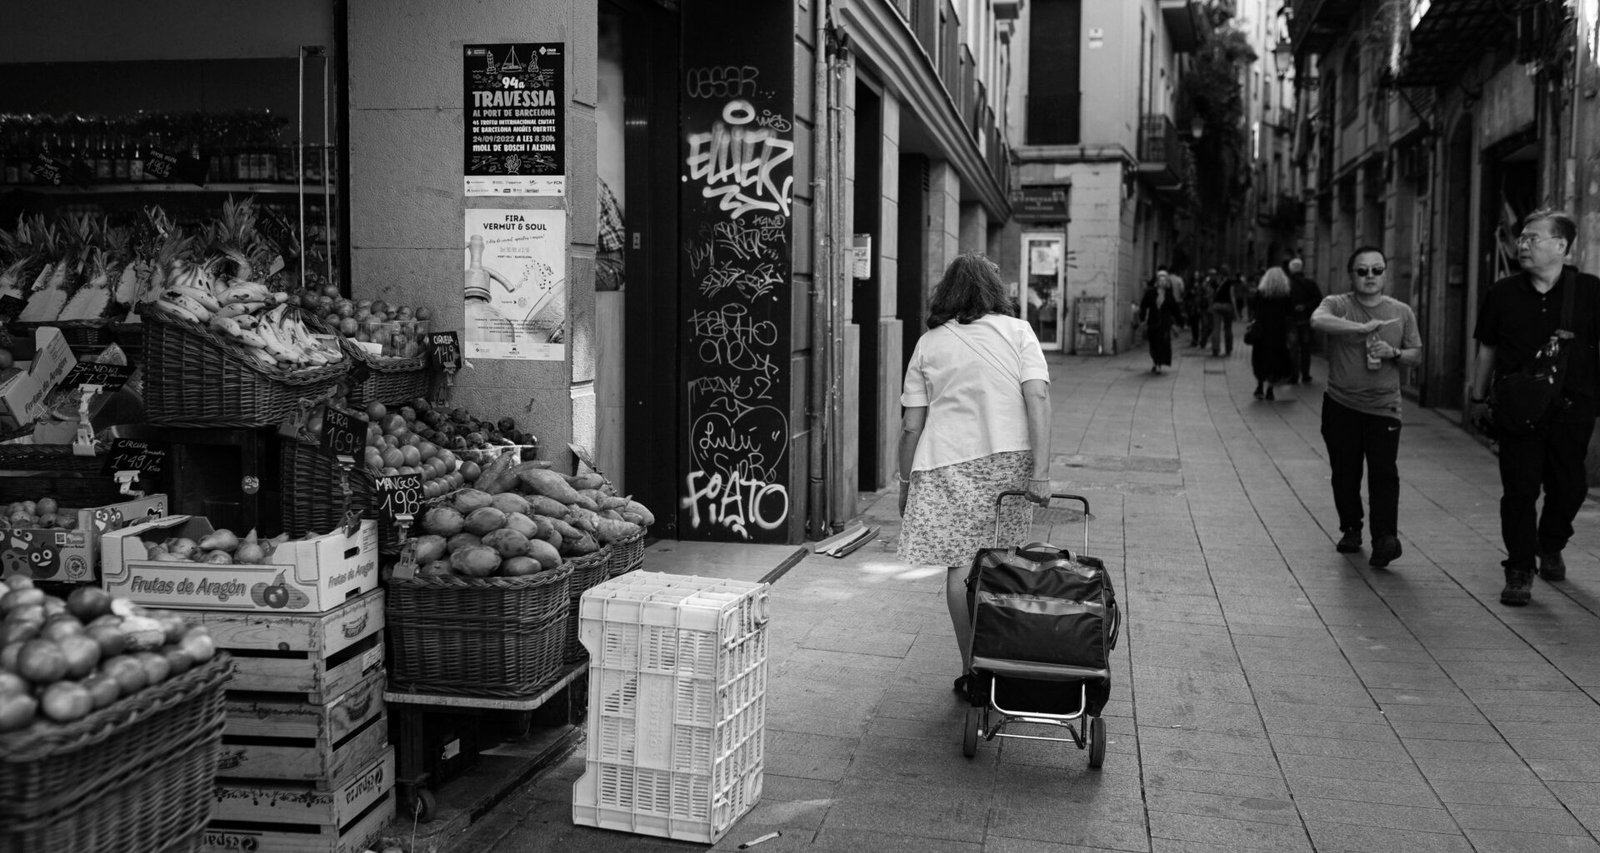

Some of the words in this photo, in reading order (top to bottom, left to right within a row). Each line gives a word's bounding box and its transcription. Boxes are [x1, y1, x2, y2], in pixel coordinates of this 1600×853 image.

[472, 90, 556, 107] TRAVESSIA
[473, 109, 481, 117] AL
[483, 109, 501, 117] PORT
[473, 144, 491, 152] MOLL
[504, 144, 525, 152] BOSCH
[327, 409, 348, 428] PERA
[375, 476, 420, 491] MANGOS
[131, 576, 175, 594] Frutas
[176, 578, 195, 595] de
[195, 577, 246, 602] Aragón
